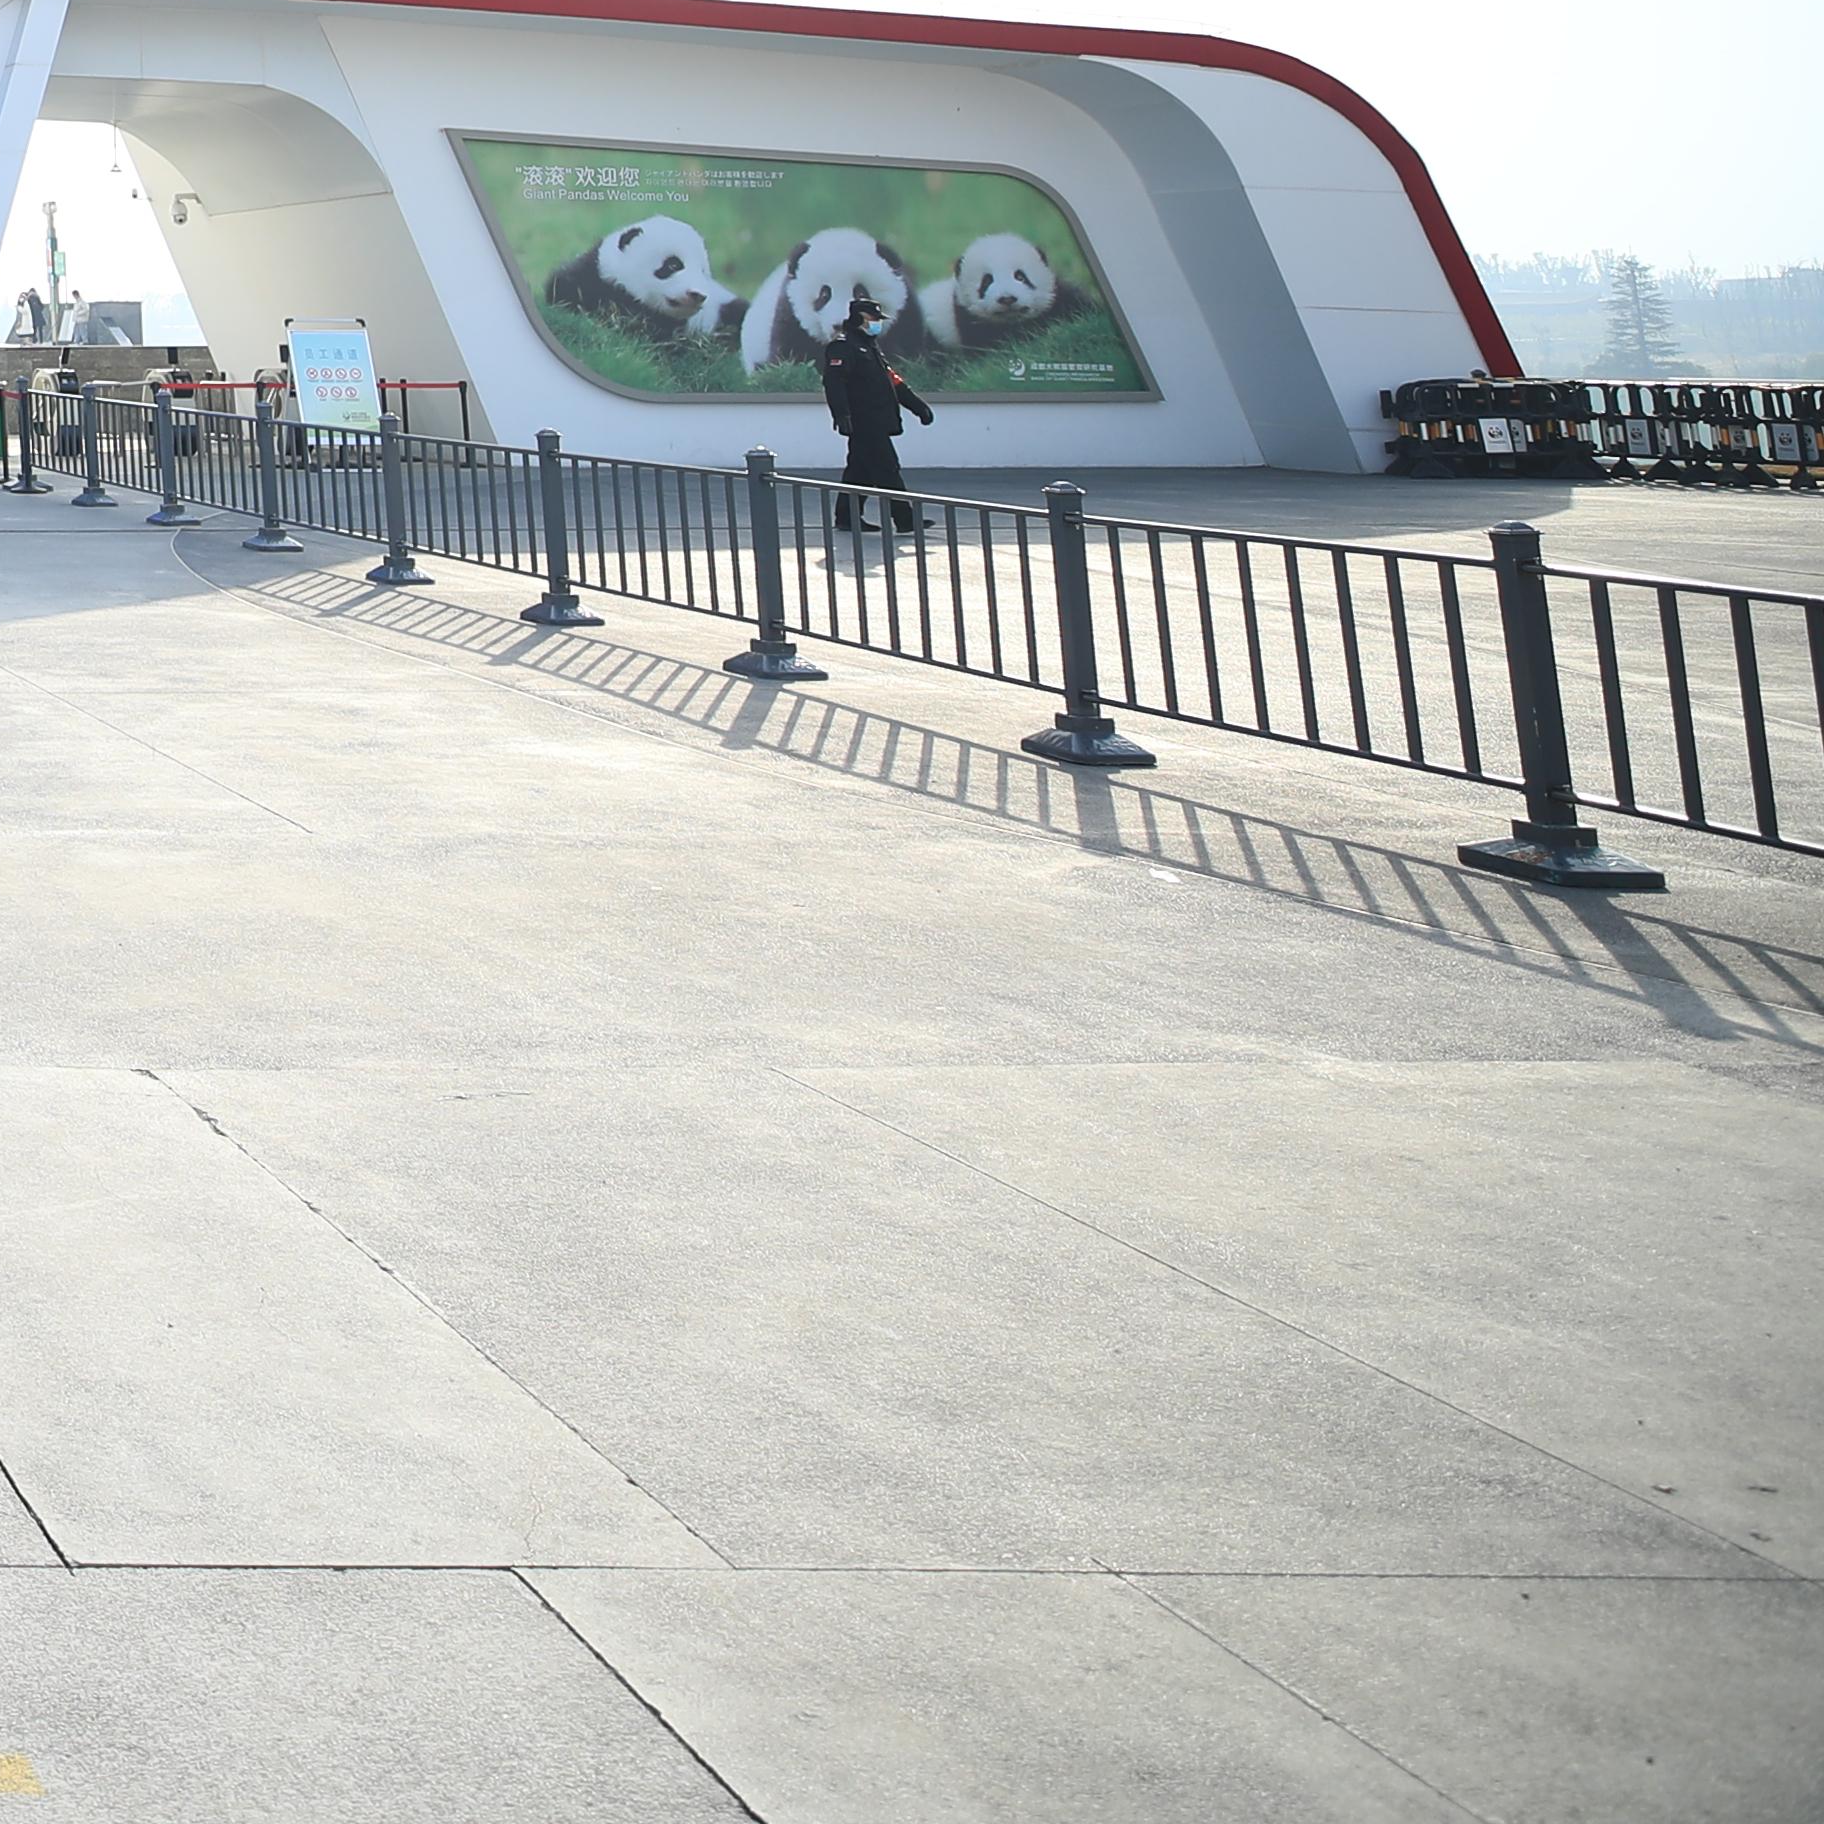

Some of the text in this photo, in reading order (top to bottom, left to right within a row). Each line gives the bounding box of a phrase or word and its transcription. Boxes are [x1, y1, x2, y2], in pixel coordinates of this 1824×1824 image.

[523, 189, 689, 202] Giant Pandas Welcome You
